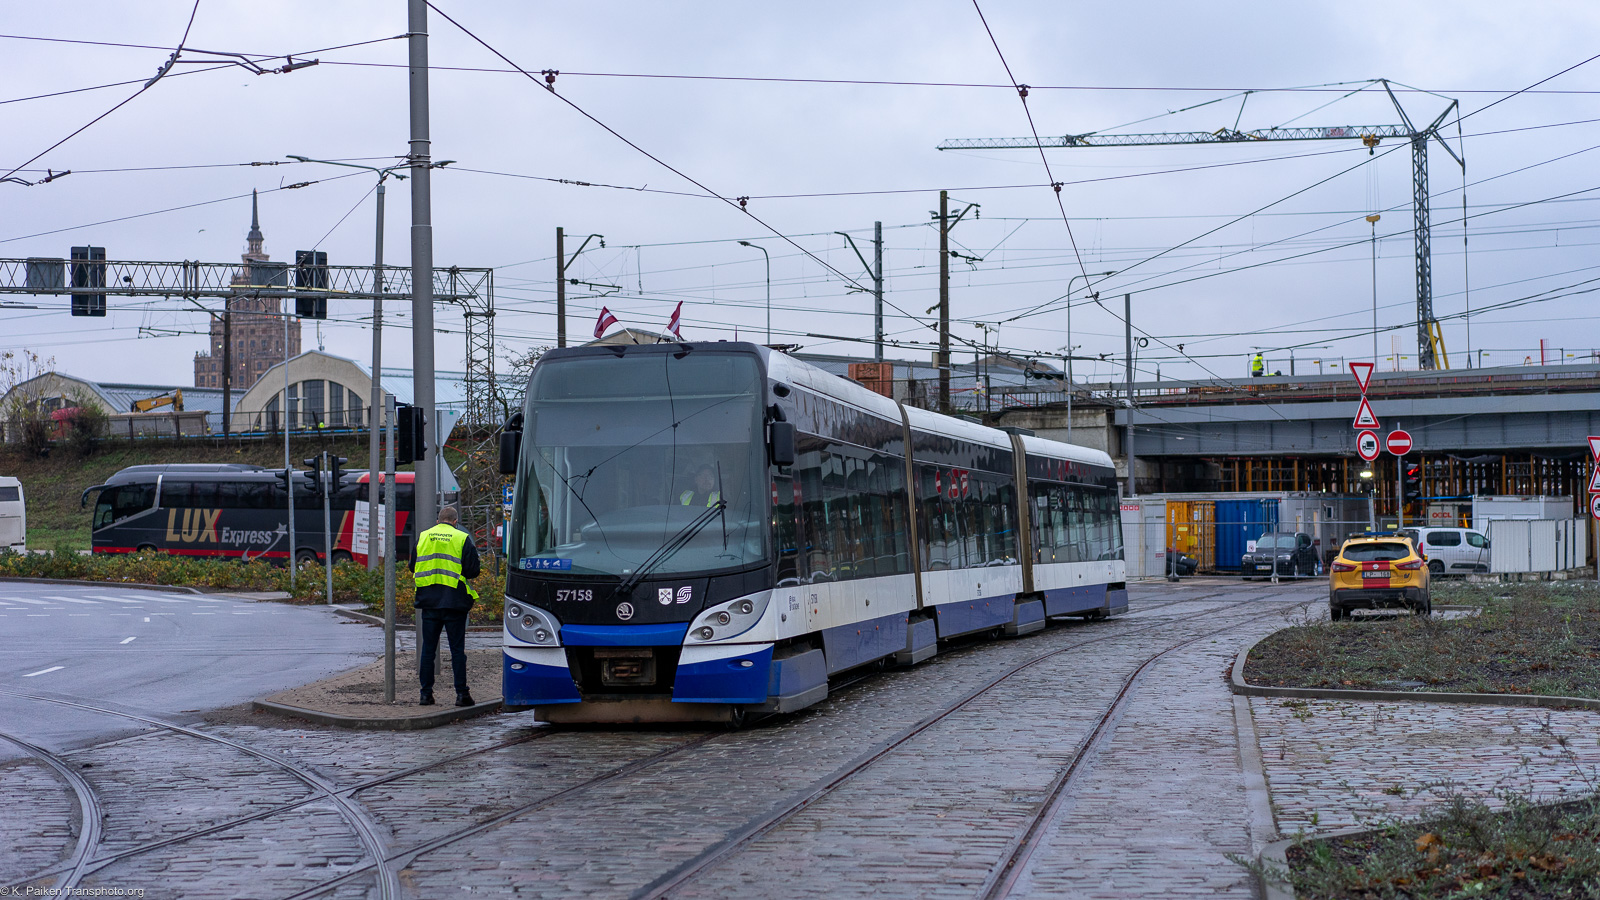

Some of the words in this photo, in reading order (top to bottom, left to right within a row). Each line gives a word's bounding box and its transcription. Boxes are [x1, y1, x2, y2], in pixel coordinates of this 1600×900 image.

[166, 508, 223, 543] LUX
[221, 527, 272, 547] Express
[556, 589, 593, 602] 57158
